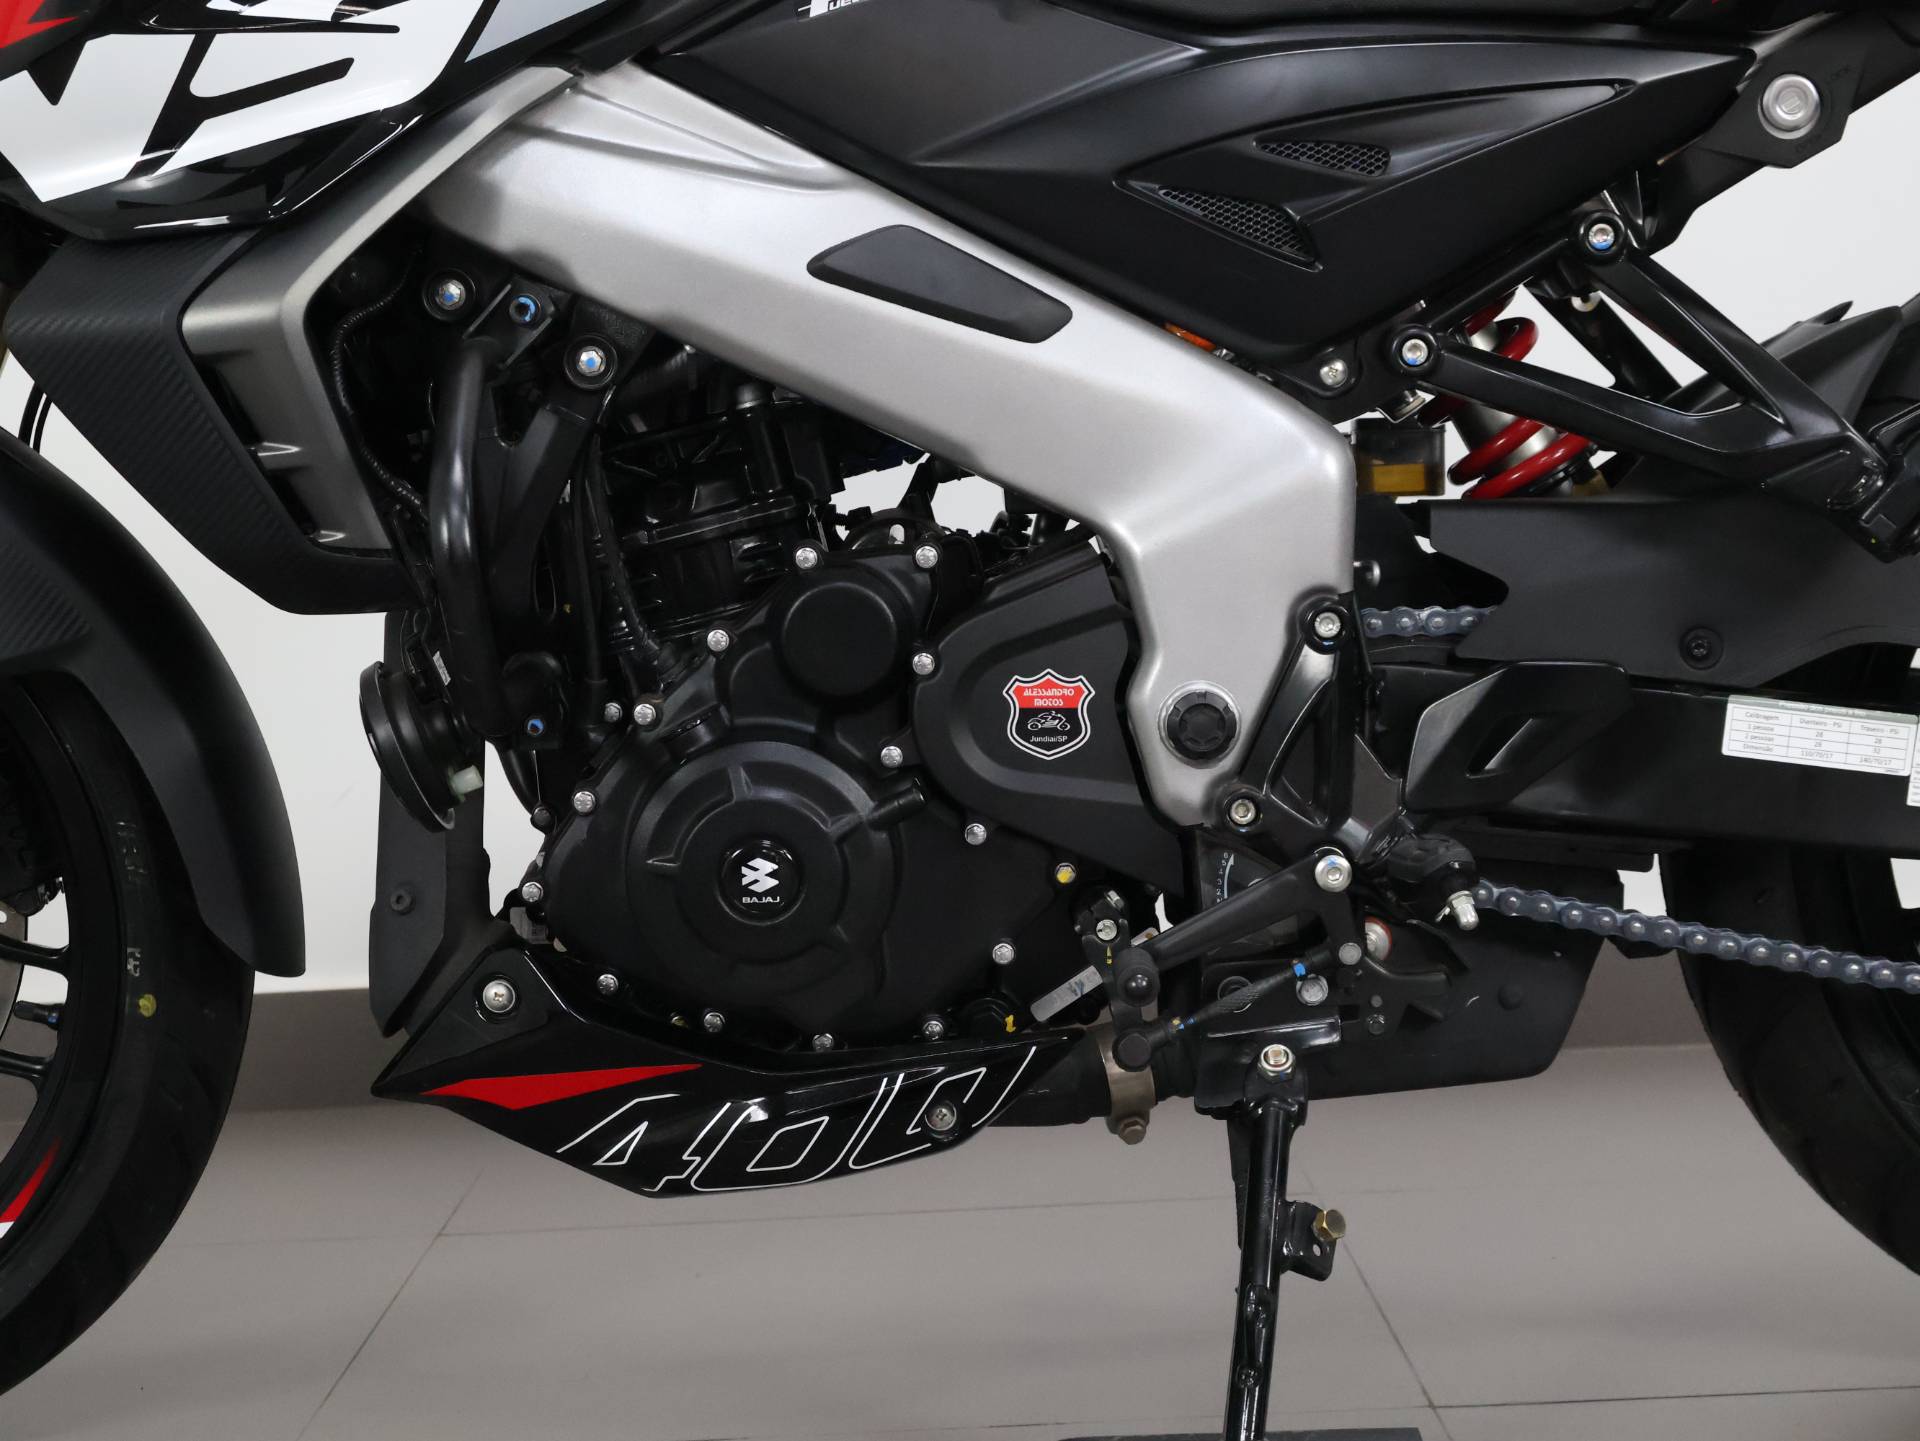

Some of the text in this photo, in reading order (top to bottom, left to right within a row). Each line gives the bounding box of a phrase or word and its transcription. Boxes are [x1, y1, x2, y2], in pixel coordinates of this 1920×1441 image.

[1023, 688, 1075, 696] ALESSANDRO
[1034, 698, 1064, 706] MOTOS
[742, 896, 780, 904] BAJAJ
